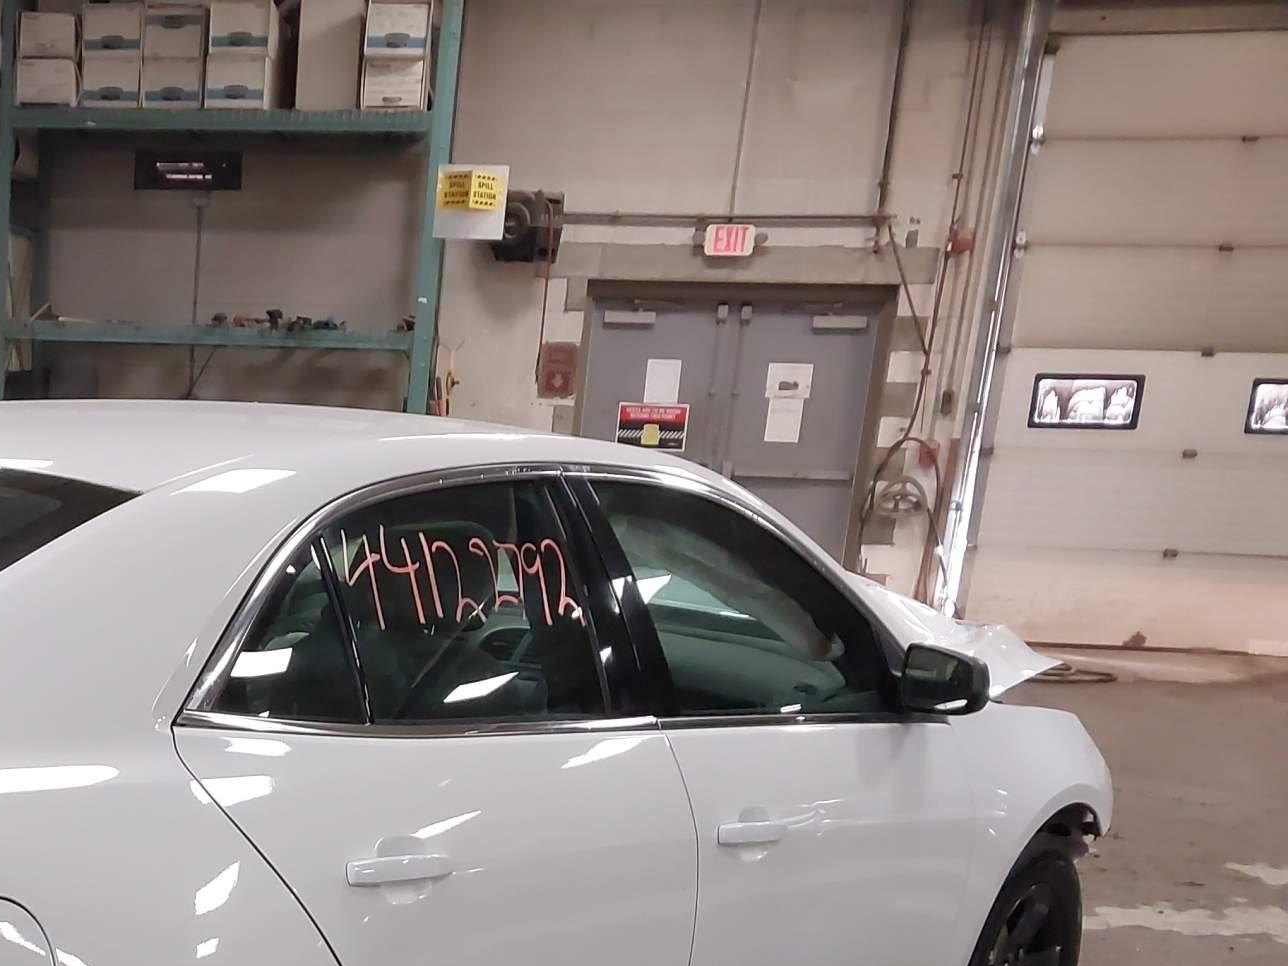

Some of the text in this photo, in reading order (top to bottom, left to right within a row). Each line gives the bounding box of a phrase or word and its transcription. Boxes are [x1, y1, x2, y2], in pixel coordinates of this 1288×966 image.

[473, 190, 497, 201] STATION
[477, 181, 495, 191] SPILL
[713, 226, 749, 253] EXIT
[342, 523, 587, 631] 44122792
